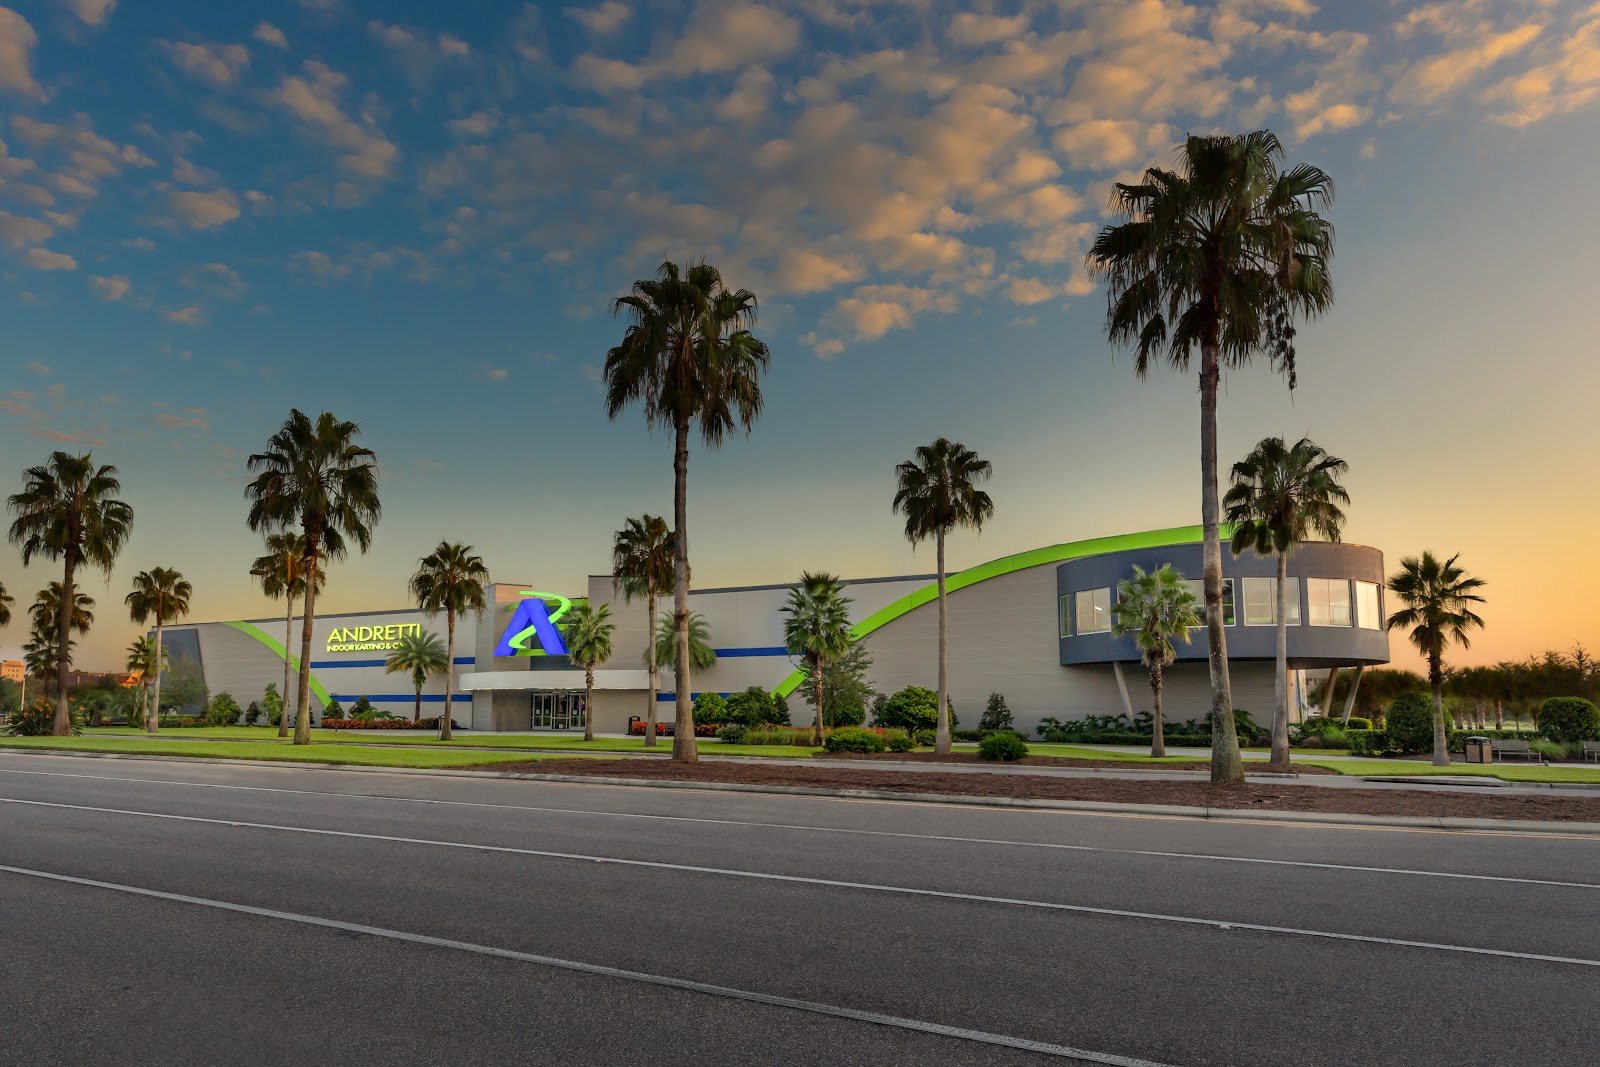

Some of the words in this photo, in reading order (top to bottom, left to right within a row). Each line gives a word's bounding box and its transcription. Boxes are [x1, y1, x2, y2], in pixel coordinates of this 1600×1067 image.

[327, 623, 421, 643] ANDRETTI
[326, 644, 354, 652] INDOOR
[355, 643, 385, 651] KARTING
[386, 642, 391, 650] &
